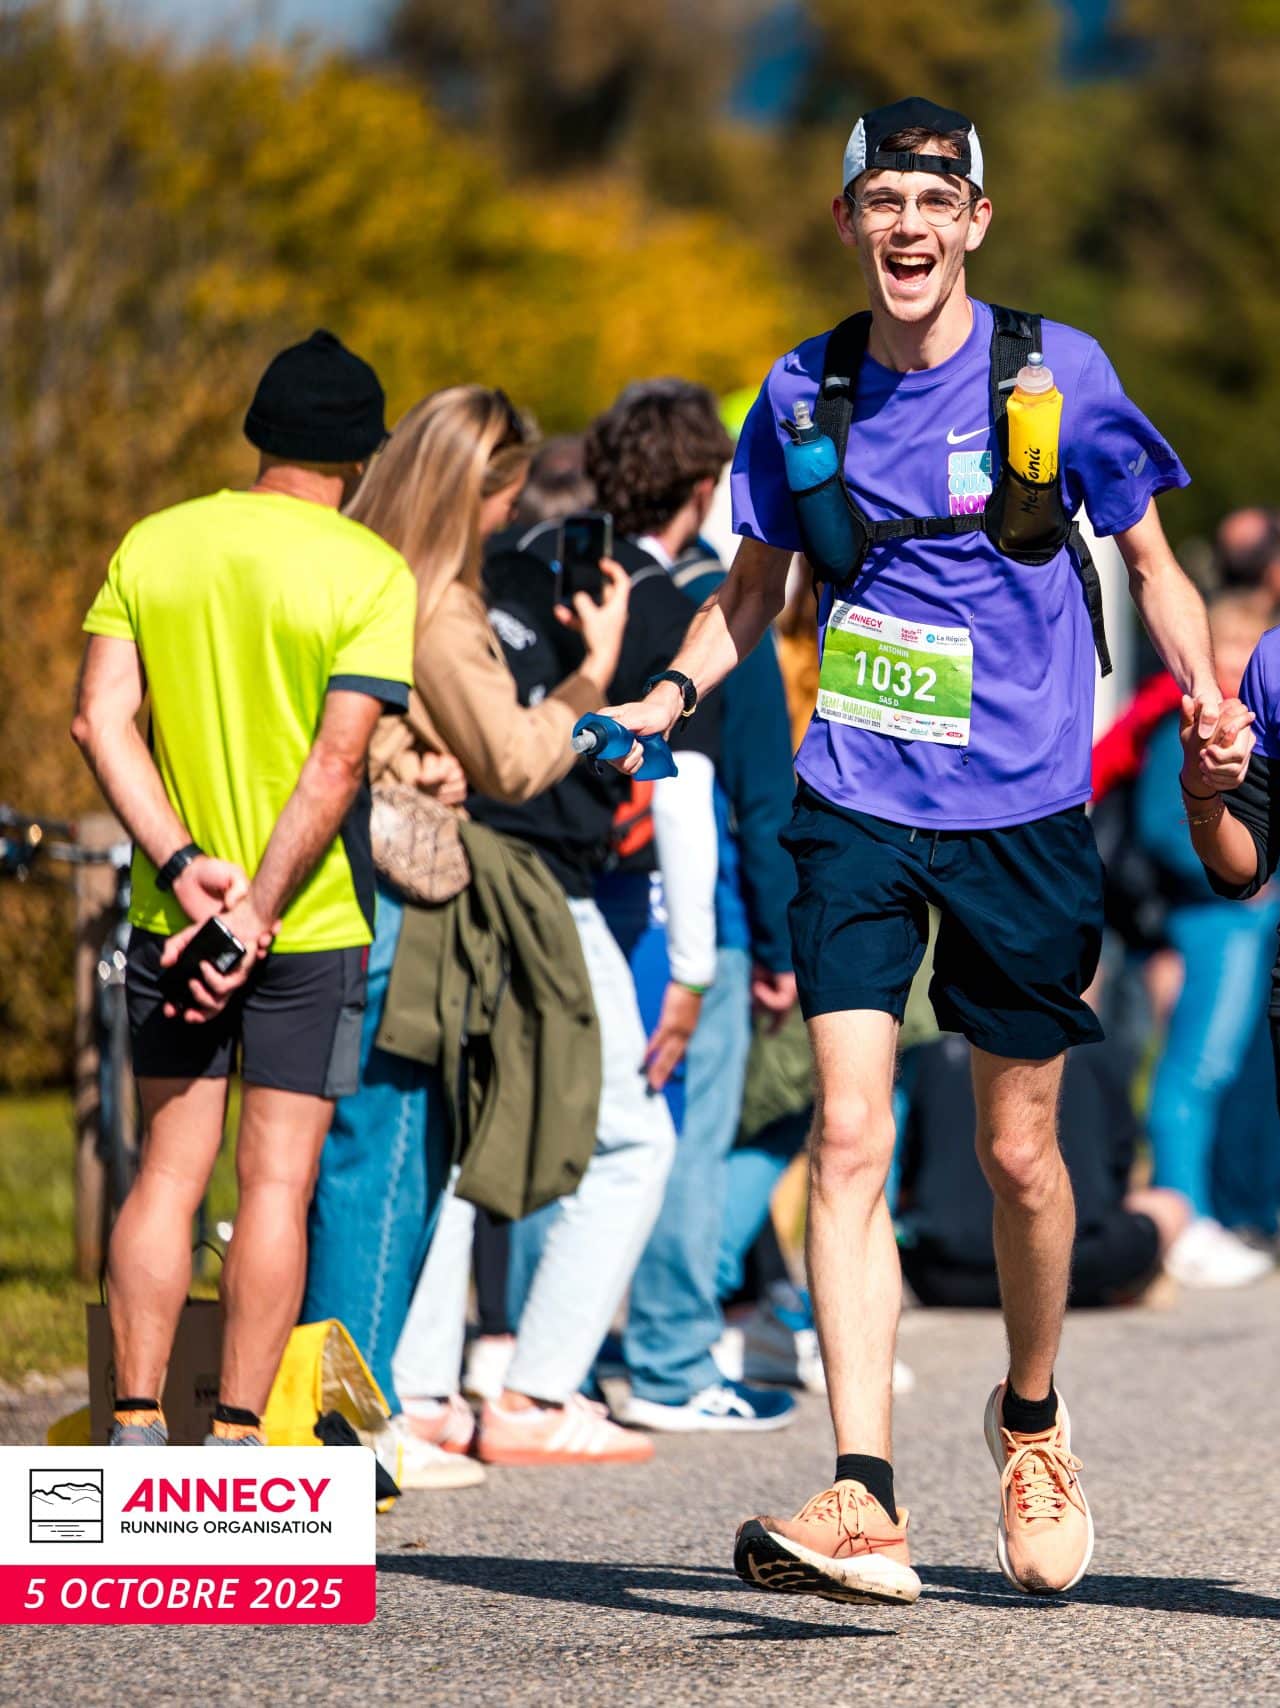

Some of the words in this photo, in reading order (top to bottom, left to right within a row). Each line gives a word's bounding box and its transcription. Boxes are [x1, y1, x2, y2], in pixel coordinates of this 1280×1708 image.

[949, 452, 992, 473] SINE
[949, 473, 992, 495] QUA
[849, 612, 883, 629] ANNECY
[854, 651, 937, 703] 1032
[879, 695, 895, 706] SAS
